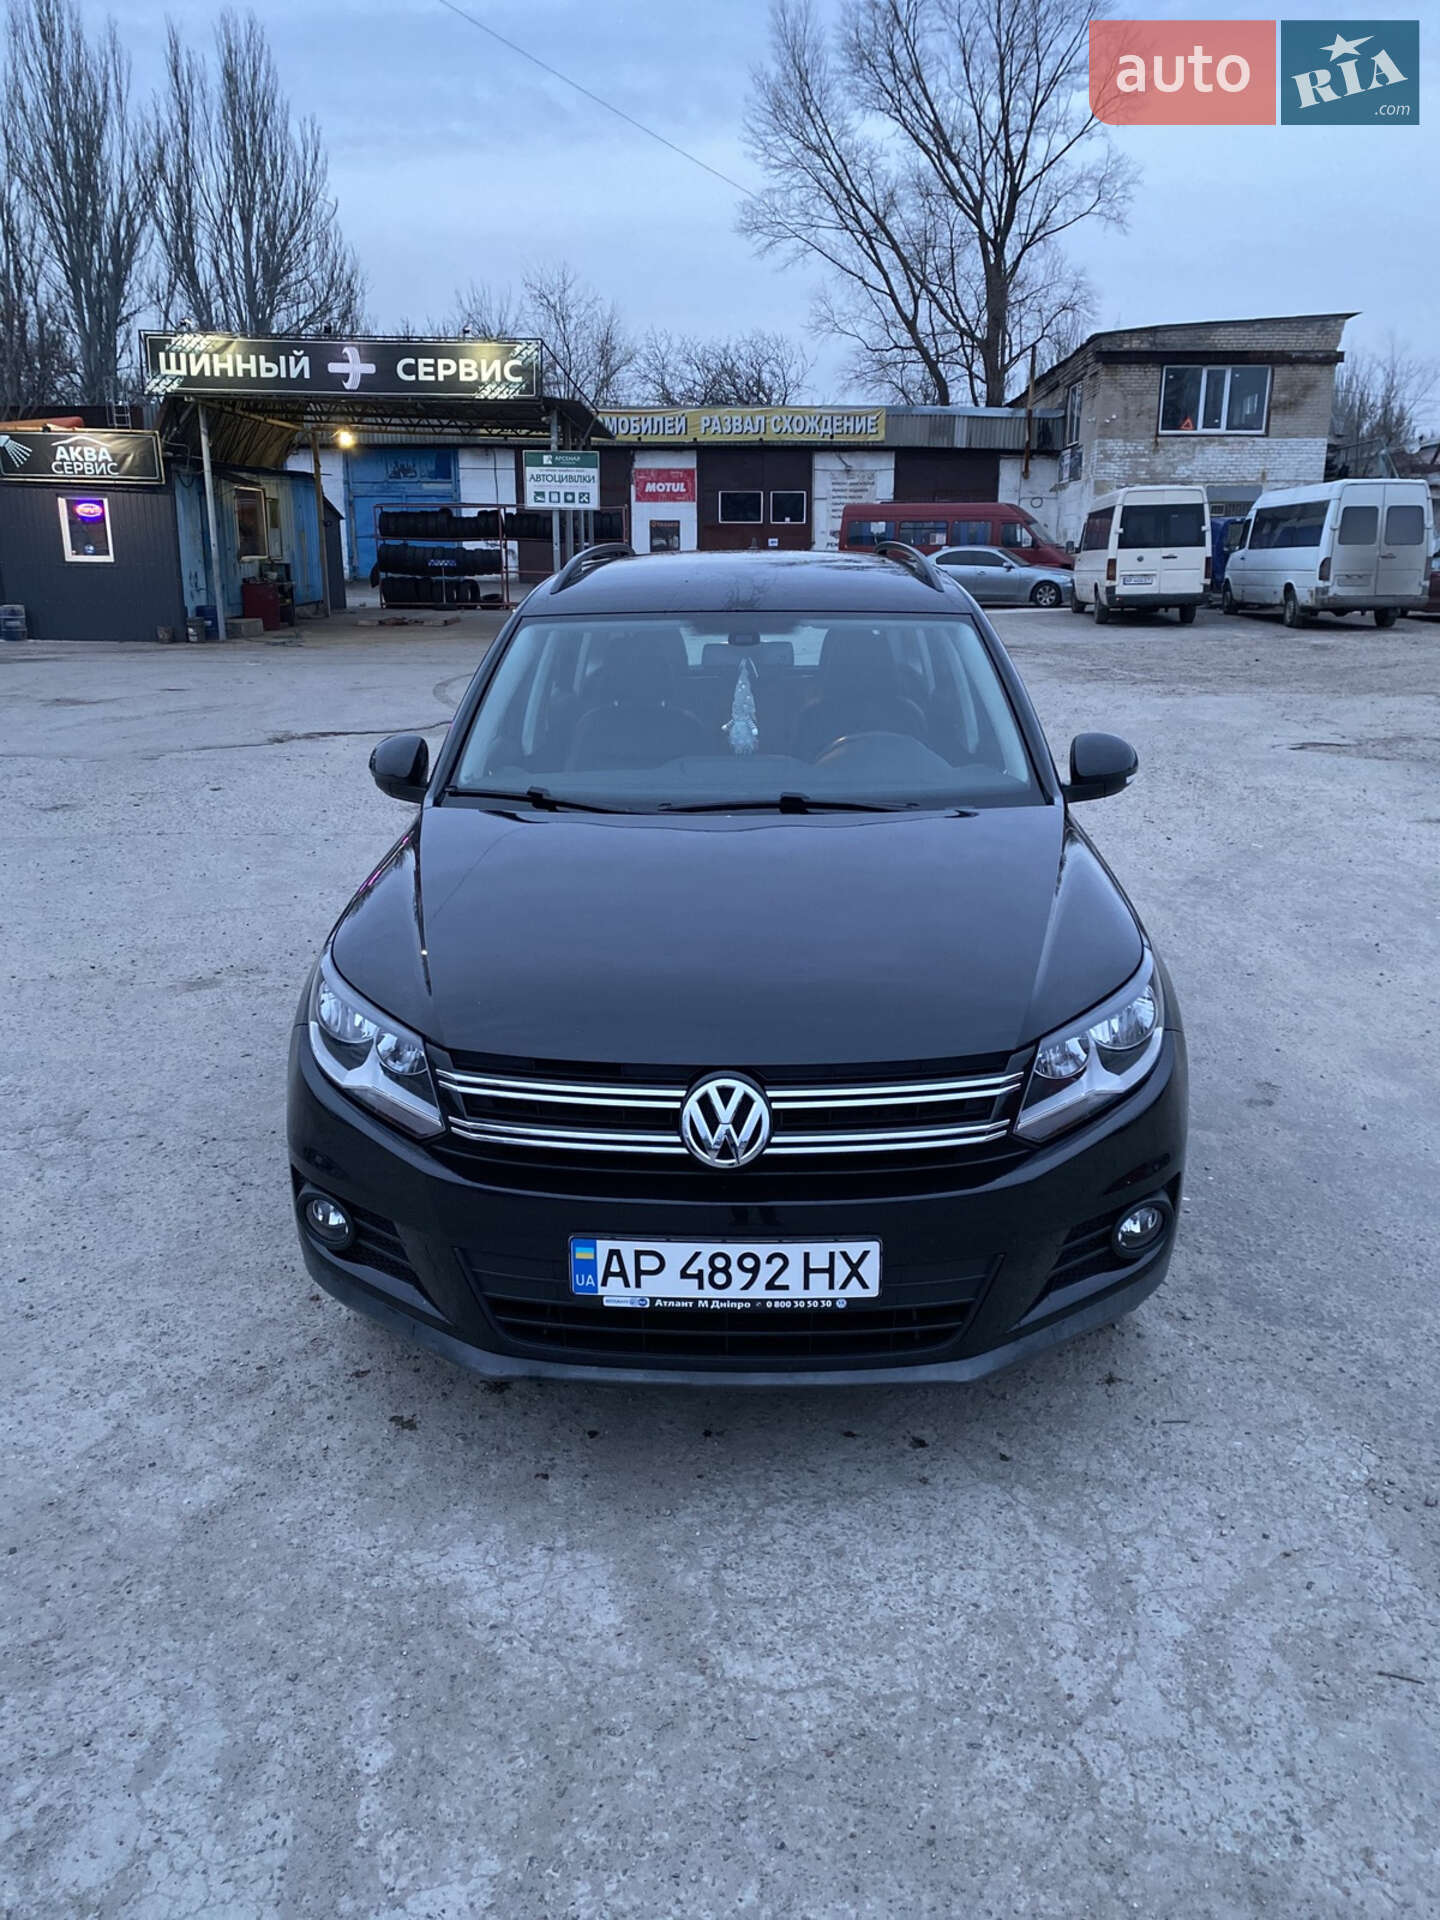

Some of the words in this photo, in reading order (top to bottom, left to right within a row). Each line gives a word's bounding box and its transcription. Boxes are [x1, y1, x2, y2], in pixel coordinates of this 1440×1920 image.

[158, 349, 311, 379] ШИННЫЙ
[396, 357, 524, 383] СЕРВИС
[599, 412, 688, 436] МОБИЛЕЙ
[701, 415, 766, 435] РАЗВАЛ
[770, 414, 879, 438] СХОЖДЕНИЕ
[55, 446, 113, 462] АКВА
[51, 461, 120, 476] СЕРВИС
[529, 473, 596, 484] АВТОЦИВІЛКИ
[645, 482, 687, 493] MOTUL
[575, 1274, 596, 1287] UA
[601, 1248, 666, 1289] AP
[680, 1251, 790, 1291] 4892
[803, 1250, 871, 1290] HX
[654, 1299, 694, 1308] Атлант
[710, 1300, 751, 1310] Дніпро
[774, 1300, 792, 1308] 800
[793, 1300, 805, 1308] 30
[820, 1300, 832, 1308] 30
